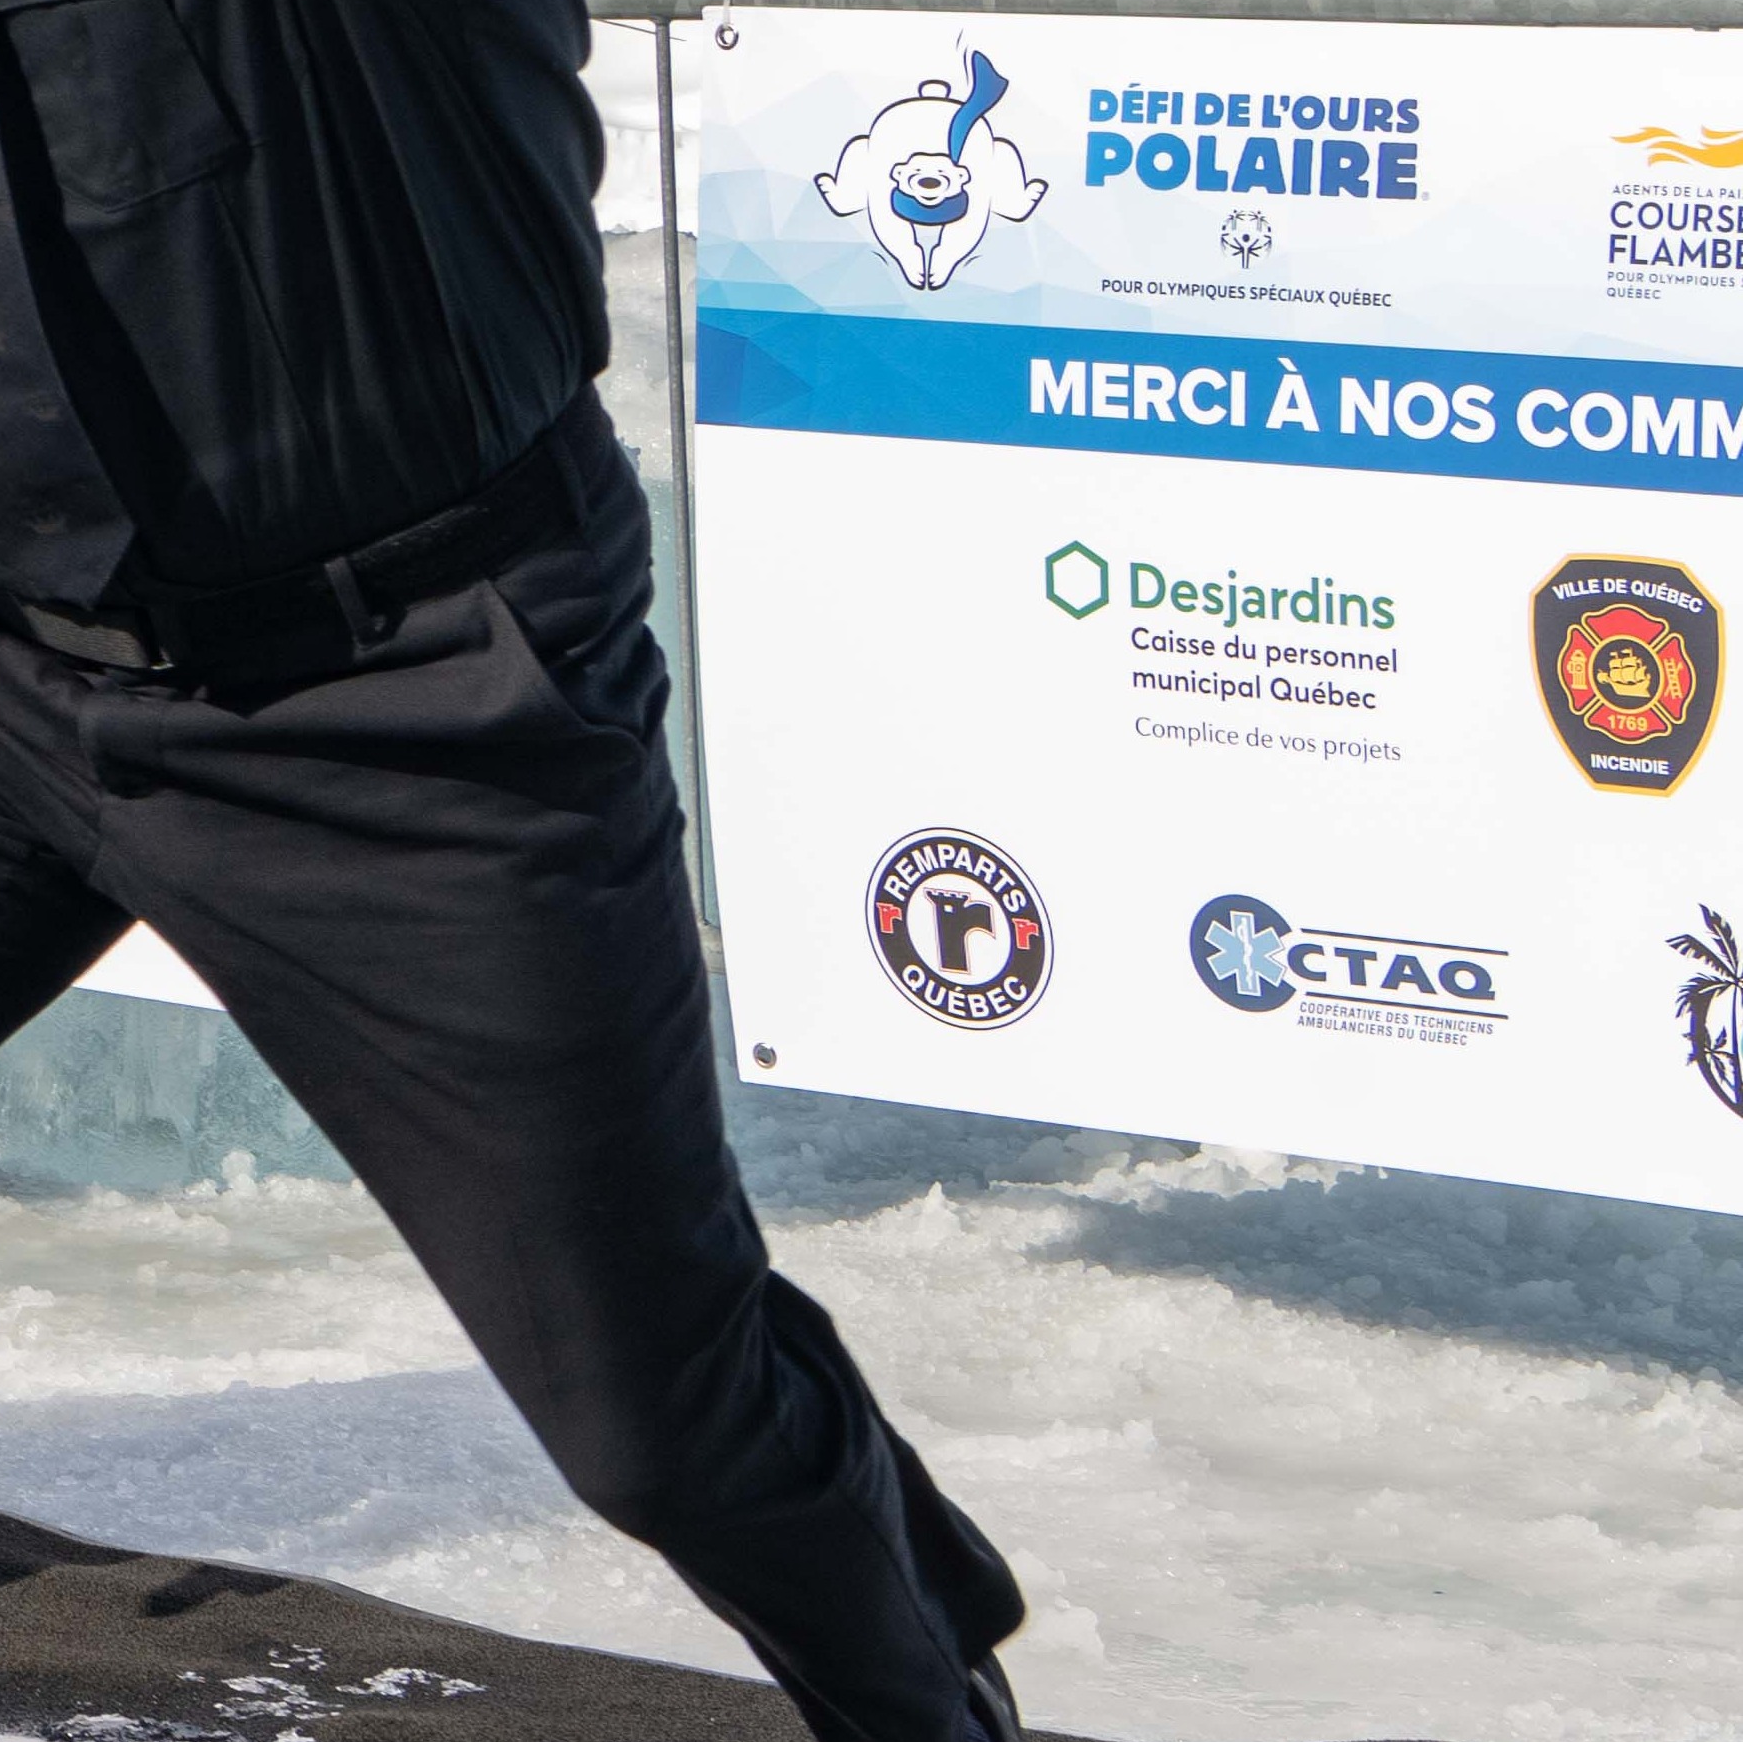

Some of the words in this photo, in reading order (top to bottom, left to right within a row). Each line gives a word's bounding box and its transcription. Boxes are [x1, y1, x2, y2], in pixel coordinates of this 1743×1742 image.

[1088, 80, 1185, 127] DÉFI
[1194, 91, 1251, 130] DE
[1261, 93, 1420, 135] L'OURS
[1084, 129, 1419, 201] POLAIRE
[1612, 184, 1669, 197] AGENTS
[1673, 186, 1691, 198] DE
[1696, 187, 1714, 199] LA
[1719, 188, 1743, 200] PAI
[1101, 279, 1144, 294] POUR
[1147, 281, 1246, 301] OLYMPIQUES
[1249, 284, 1326, 304] SPÉCIAUX
[1328, 288, 1393, 308] QUÉBEC
[1606, 285, 1662, 300] QUÉBEC
[1607, 271, 1644, 283] POUR
[1648, 273, 1735, 288] OLYMPIQUES
[1028, 357, 1246, 428] MERCI
[1265, 357, 1320, 432] À
[1339, 378, 1496, 444] NOS
[1516, 388, 1743, 461] COMM
[1128, 560, 1396, 630] Desjardins
[1551, 576, 1601, 602] VILLE
[1602, 576, 1628, 595] DE
[1629, 578, 1705, 615] QUÉBEC
[1130, 626, 1216, 659] Caisse
[1223, 635, 1258, 661] du
[1265, 642, 1399, 673] personnel
[1131, 665, 1262, 701] municipal
[1269, 675, 1377, 711] Québec
[1134, 715, 1239, 749] Complice
[1246, 724, 1274, 749] de
[1279, 733, 1318, 754] vos
[1322, 734, 1402, 763] projets
[1606, 711, 1648, 733] 1769
[1590, 752, 1671, 776] INCENDIE
[882, 843, 1028, 914] REMPARTS
[901, 963, 1028, 1019] QUÉBEC
[1286, 942, 1496, 1001] CTAQ
[1296, 1015, 1393, 1038] AMBULANCIERS
[1397, 1026, 1415, 1040] DU
[1418, 1026, 1468, 1047] QUÉBEC
[1299, 1000, 1381, 1023] COOPÉRATIVE
[1385, 1011, 1410, 1025] DES
[1414, 1015, 1494, 1036] TECHNICIENS
